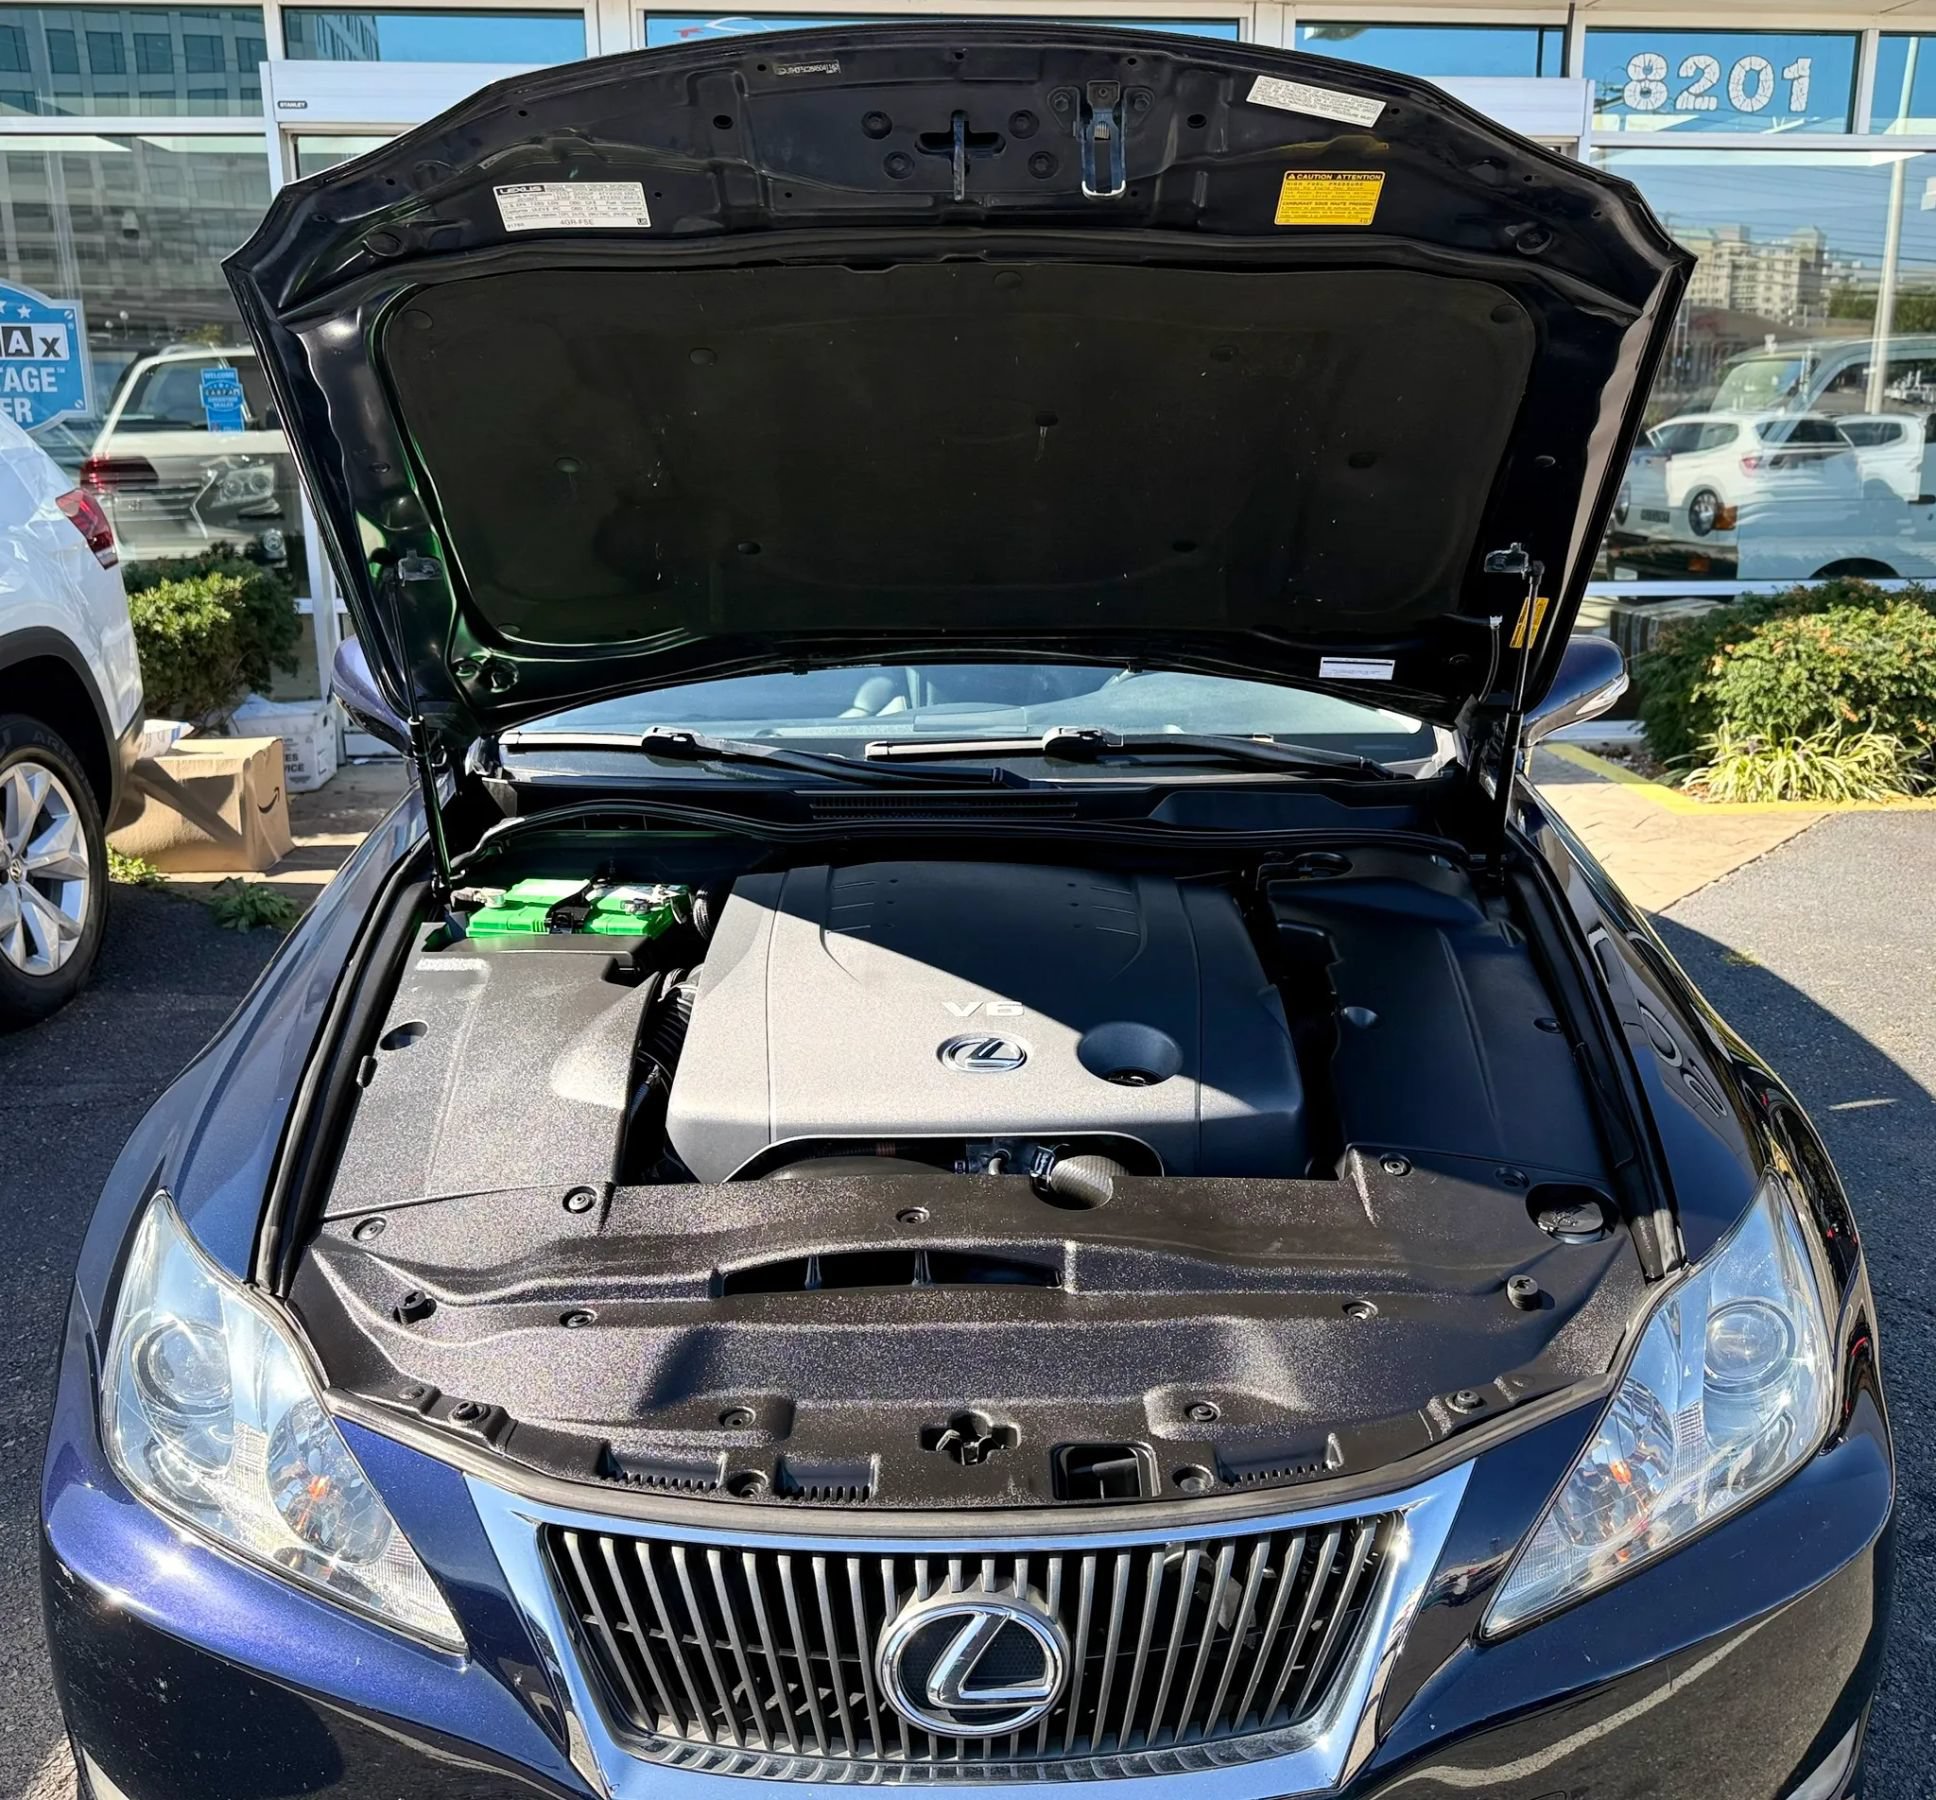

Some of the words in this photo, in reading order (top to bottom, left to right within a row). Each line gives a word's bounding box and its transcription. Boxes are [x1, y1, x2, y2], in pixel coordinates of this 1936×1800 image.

[1623, 52, 1812, 112] 8201
[500, 185, 543, 194] LEXUS
[941, 1001, 1024, 1017] V6
